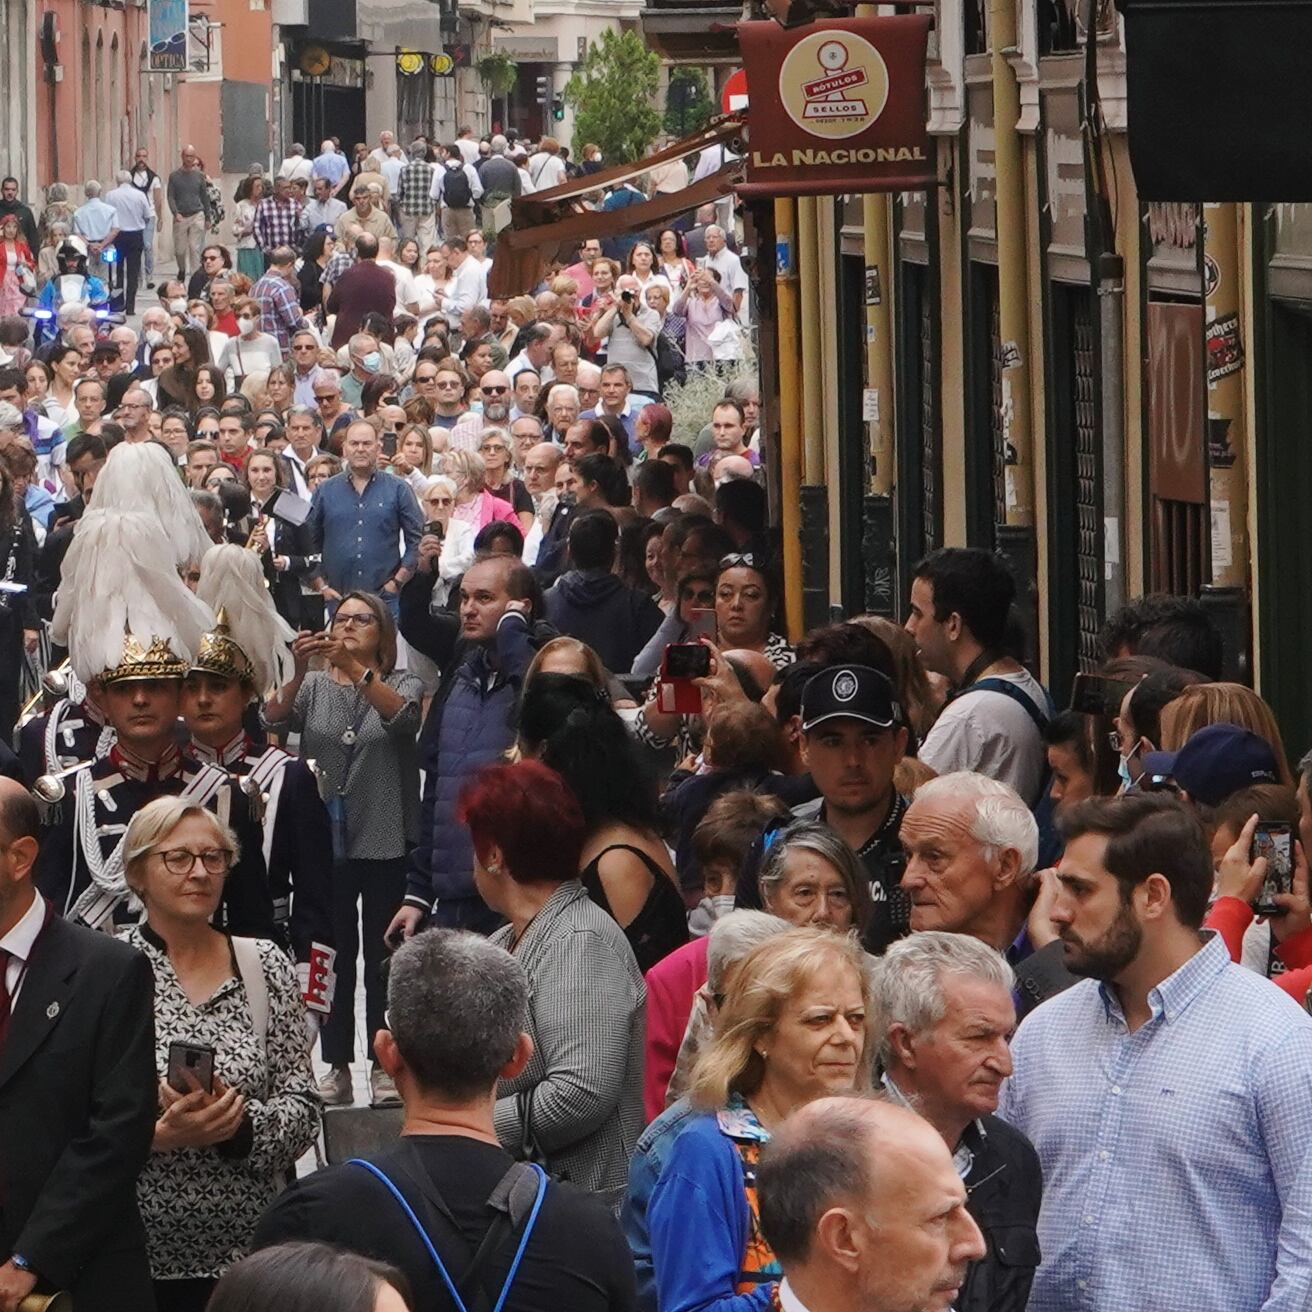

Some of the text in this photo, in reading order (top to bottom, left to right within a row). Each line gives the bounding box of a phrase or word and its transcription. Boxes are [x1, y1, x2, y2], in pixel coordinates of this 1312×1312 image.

[812, 73, 858, 94] RÓTULOS
[813, 104, 857, 113] SELLOS
[752, 147, 927, 168] LA NACIONAL
